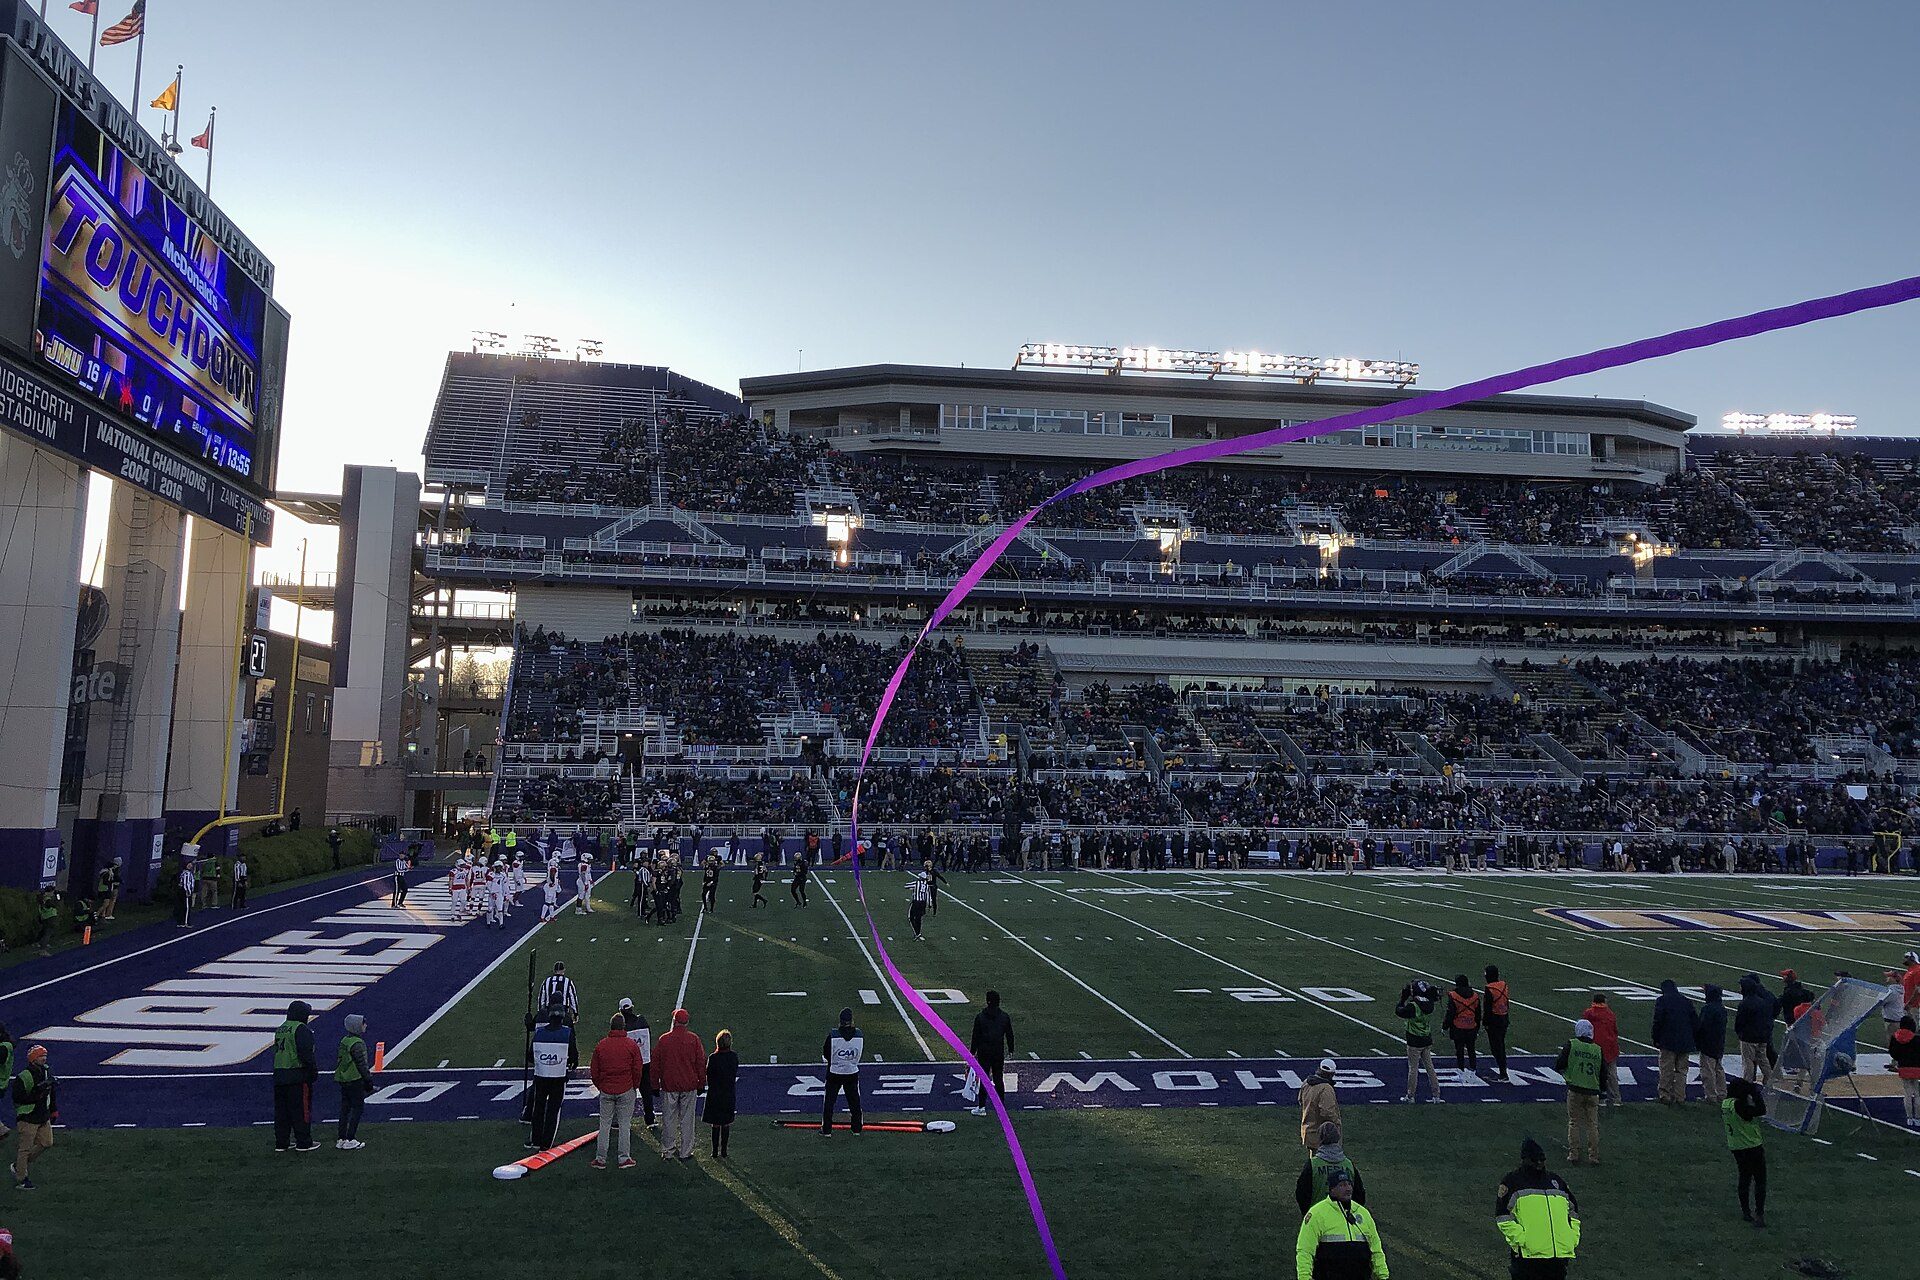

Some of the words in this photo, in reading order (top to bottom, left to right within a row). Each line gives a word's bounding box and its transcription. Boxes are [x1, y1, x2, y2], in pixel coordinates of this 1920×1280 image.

[26, 20, 98, 112] JAMES
[106, 102, 188, 198] MADISON
[194, 193, 274, 289] UNIVERSITY
[162, 235, 218, 312] McDonald's
[51, 183, 256, 416] TOUCHDOWN
[46, 337, 82, 375] JMU
[87, 360, 100, 382] 16
[142, 394, 151, 413] 0
[0, 367, 74, 424] IDGEFORTH
[0, 393, 57, 440] STADIUM
[97, 420, 151, 465] NATIONAL
[152, 450, 207, 492] CHAMPIONS
[213, 446, 220, 460] 2
[227, 447, 251, 476] 13:55
[120, 457, 150, 486] 2004
[159, 476, 183, 501] 2016
[221, 487, 239, 509] ZANE
[240, 498, 271, 525] SHOWKER
[236, 513, 255, 534] FIED
[251, 641, 264, 670] 27
[475, 870, 483, 879] 21
[21, 930, 446, 1068] JAMES
[857, 988, 971, 1005] 10
[1221, 986, 1376, 1002] 20
[539, 1053, 558, 1061] CAA
[837, 1048, 854, 1057] CAA
[1575, 1050, 1598, 1061] MEDIA
[1579, 1061, 1594, 1076] 13
